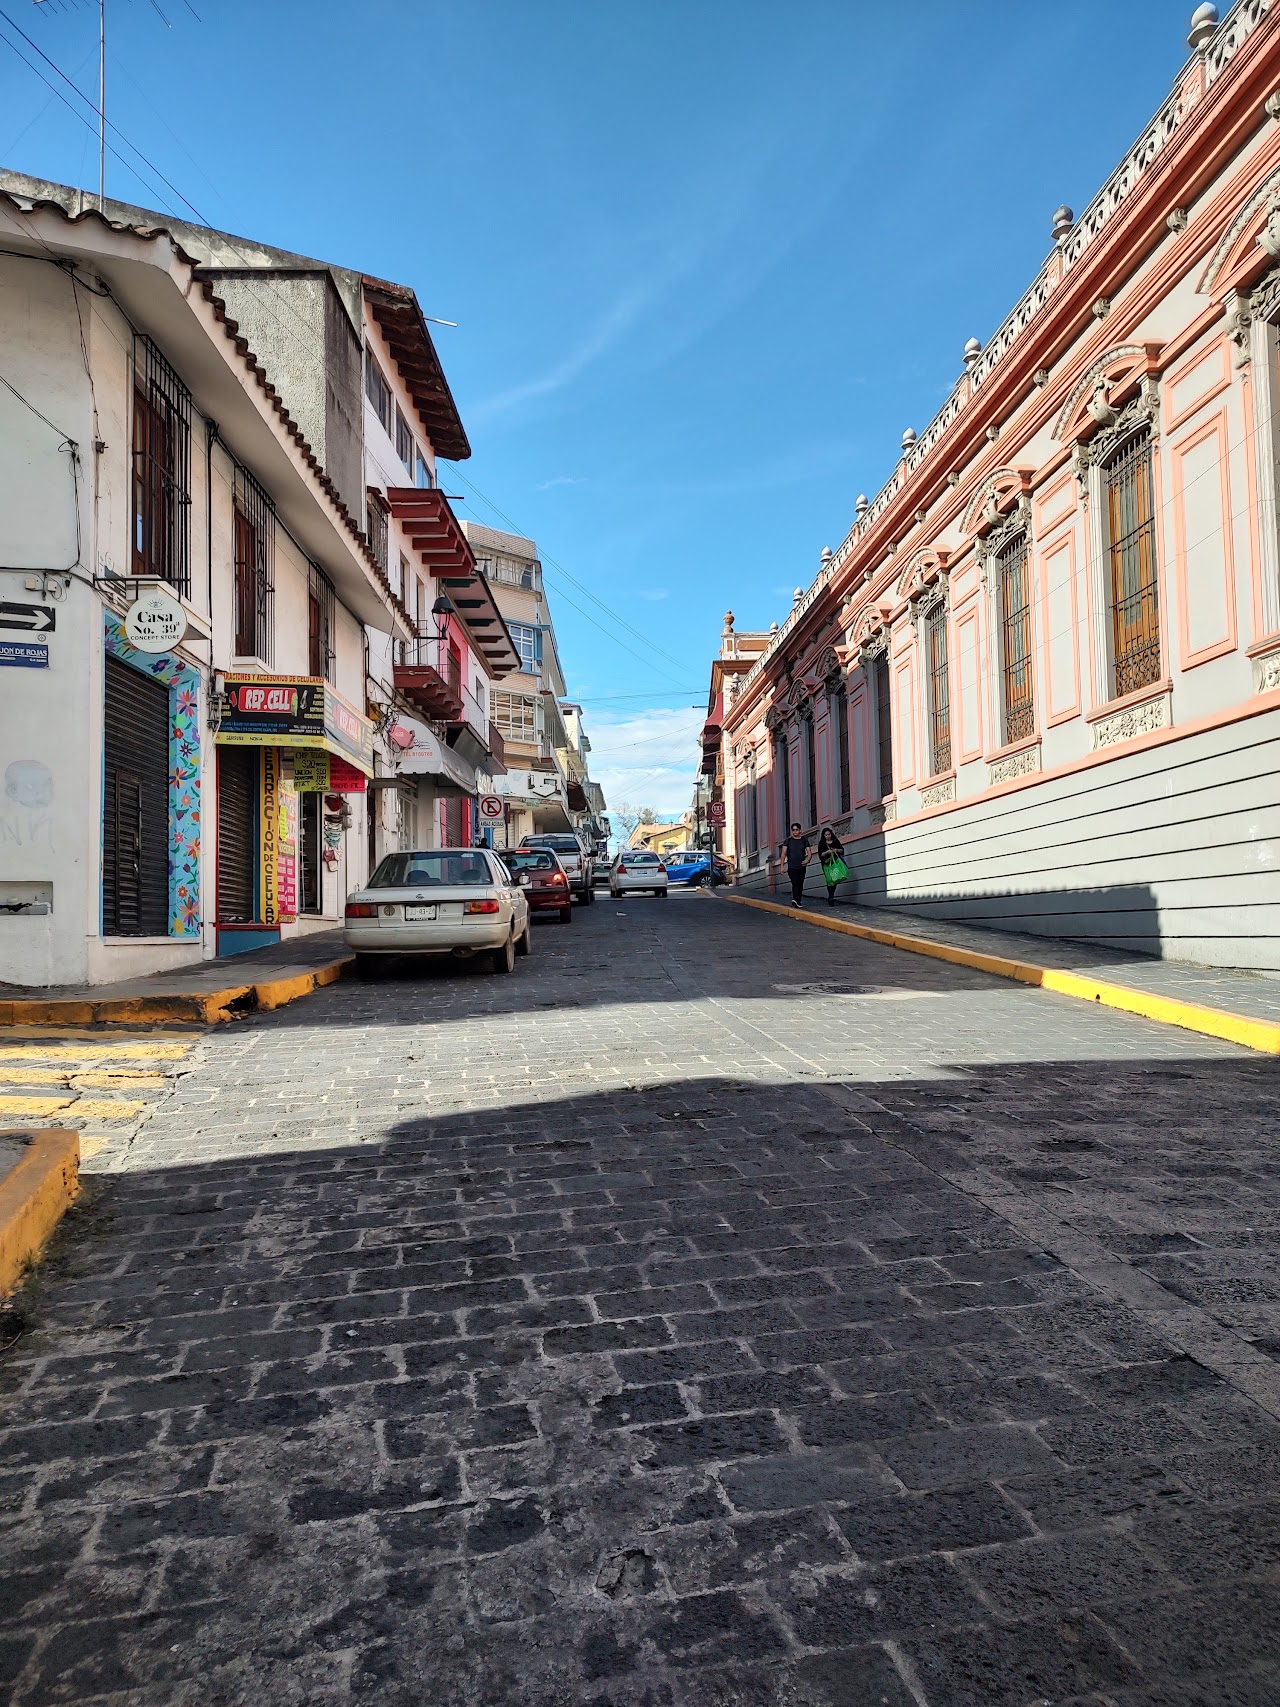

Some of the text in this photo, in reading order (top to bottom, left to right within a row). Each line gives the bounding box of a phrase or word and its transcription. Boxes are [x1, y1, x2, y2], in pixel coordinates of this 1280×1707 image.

[137, 611, 173, 623] Casa
[133, 624, 155, 635] No.
[15, 648, 25, 656] DE
[26, 649, 48, 657] ROJAS
[256, 674, 288, 682] ACCESORIOS
[289, 675, 296, 683] DE
[297, 675, 324, 684] CELULARES
[263, 853, 274, 862] DE
[264, 863, 274, 925] CELULAR
